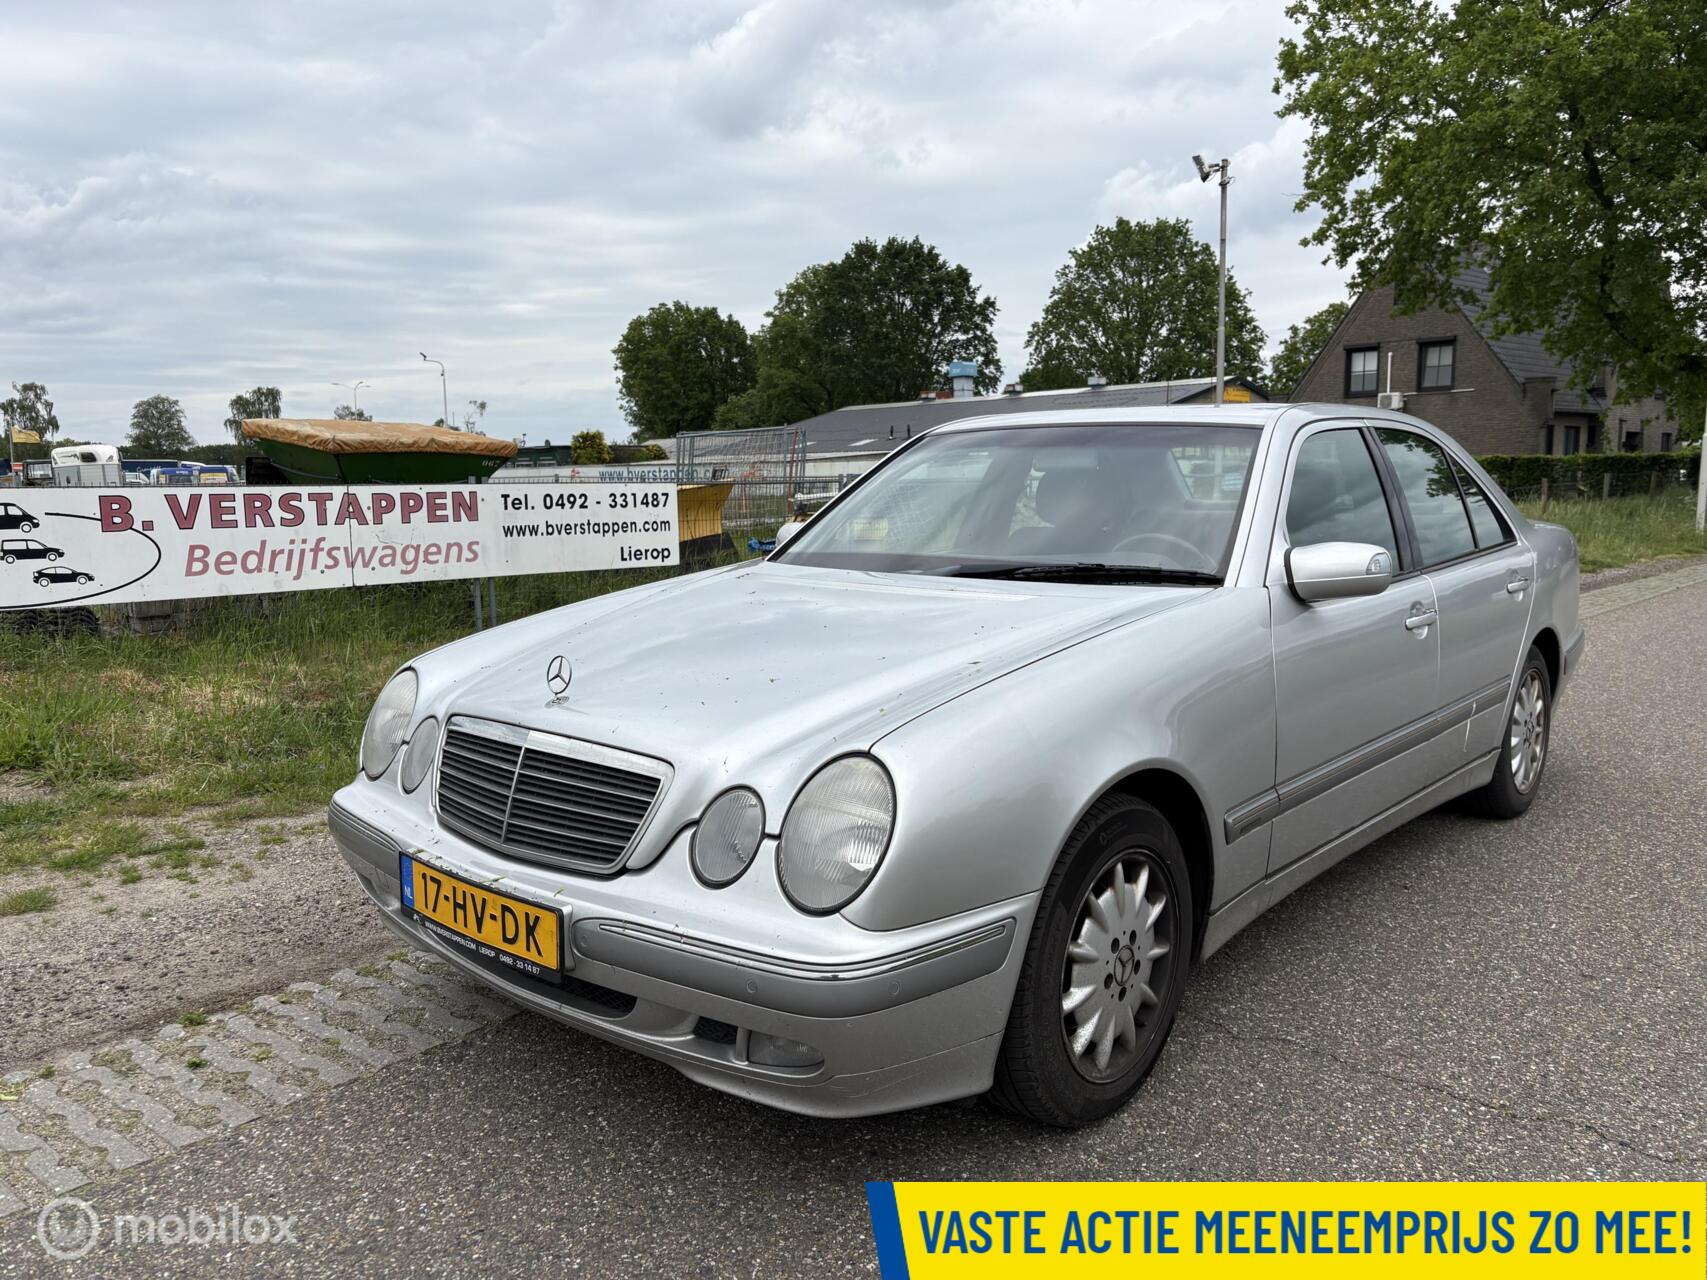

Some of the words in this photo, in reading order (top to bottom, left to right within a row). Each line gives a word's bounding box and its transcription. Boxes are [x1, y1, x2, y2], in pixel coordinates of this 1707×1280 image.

[501, 493, 536, 511] Tel.
[543, 493, 589, 510] 0492
[608, 492, 670, 509] 331487
[98, 495, 155, 533] B.
[164, 490, 479, 530] VERSTAPPEN
[502, 519, 671, 538] www.bverstappen.com
[184, 536, 480, 581] Bedrijfswagens
[620, 545, 672, 563] Lierop
[404, 886, 413, 899] NL
[421, 872, 544, 958] 17-HV-DK
